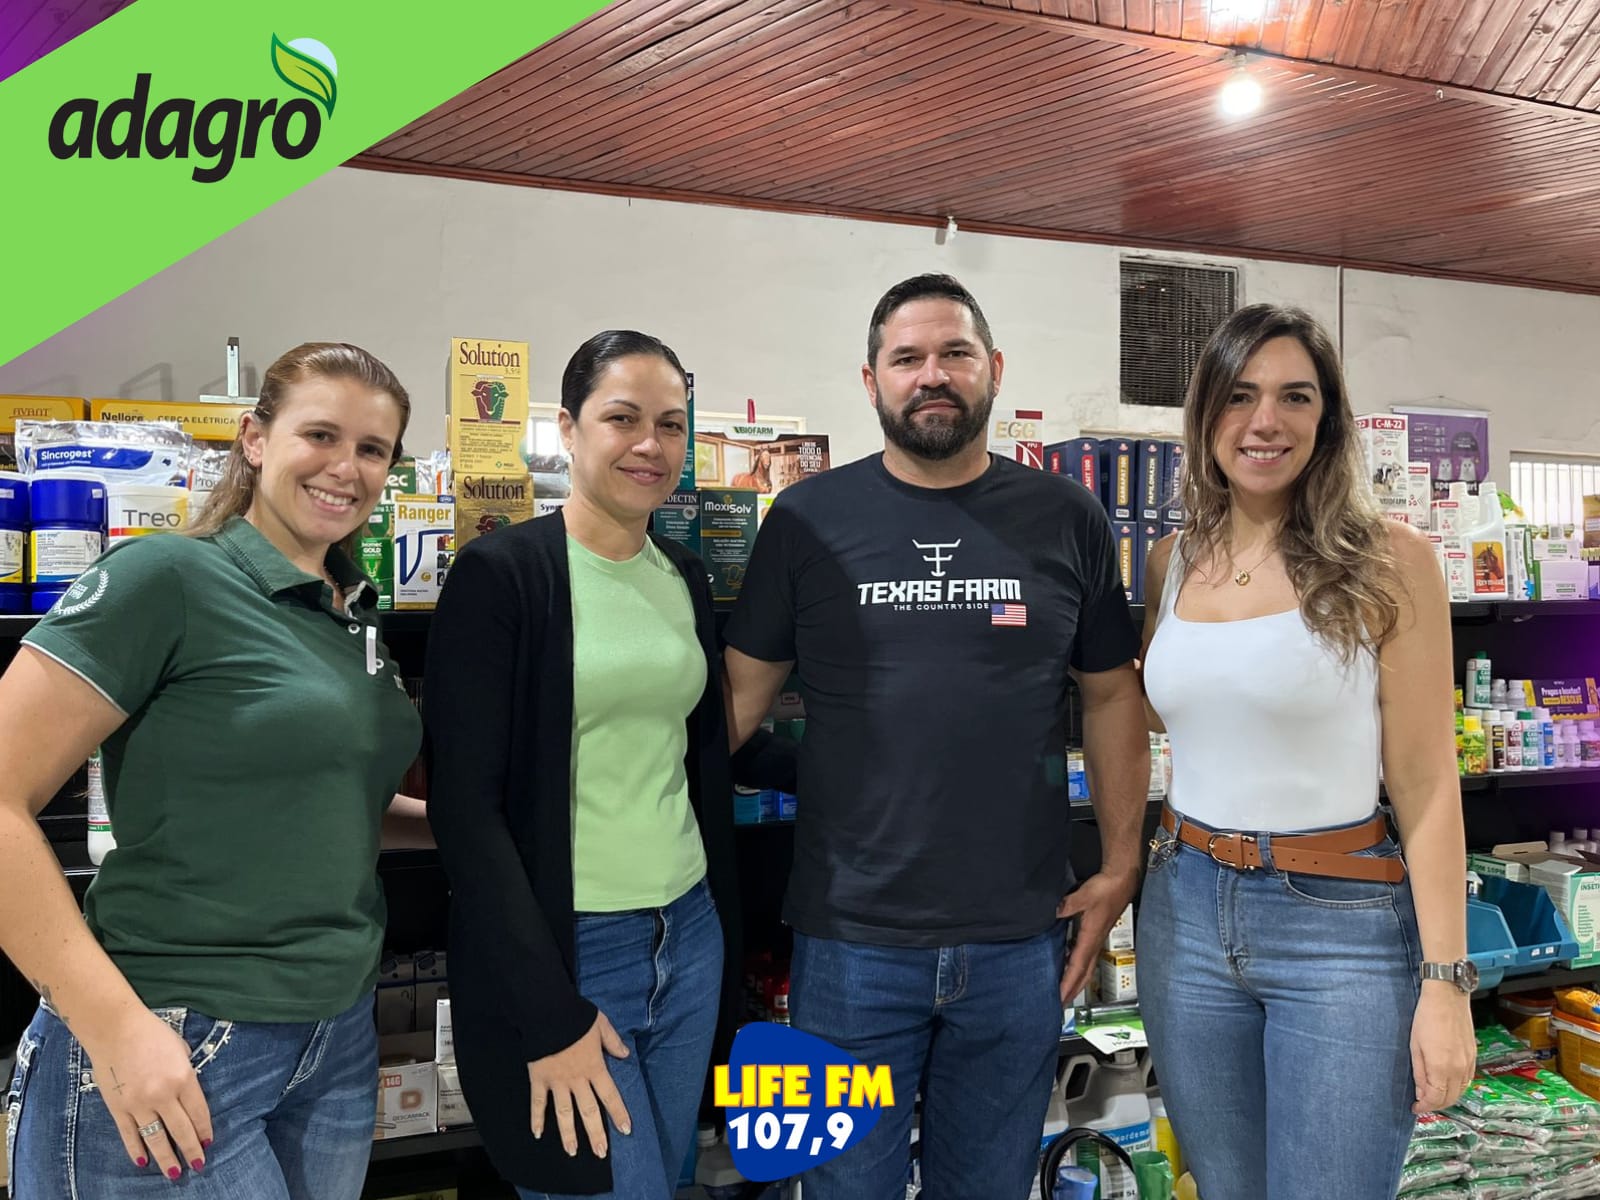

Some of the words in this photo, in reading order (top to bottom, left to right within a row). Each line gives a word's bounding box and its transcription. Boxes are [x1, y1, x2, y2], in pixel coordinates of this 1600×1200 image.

[459, 341, 520, 367] Solution
[101, 411, 145, 421] Nellore
[192, 415, 235, 425] ELÉTRICA
[740, 426, 773, 434] BIOFARM
[995, 421, 1037, 438] EGG
[1376, 420, 1402, 429] C-M-22
[41, 449, 92, 460] Sincrogest
[463, 475, 525, 500] Solution
[666, 494, 697, 504] DECTIN
[704, 501, 752, 514] MoxiSolv
[398, 504, 451, 523] Ranger
[857, 580, 942, 605] TEXAS
[947, 578, 1021, 601] FARM
[916, 603, 963, 611] COUNTRY
